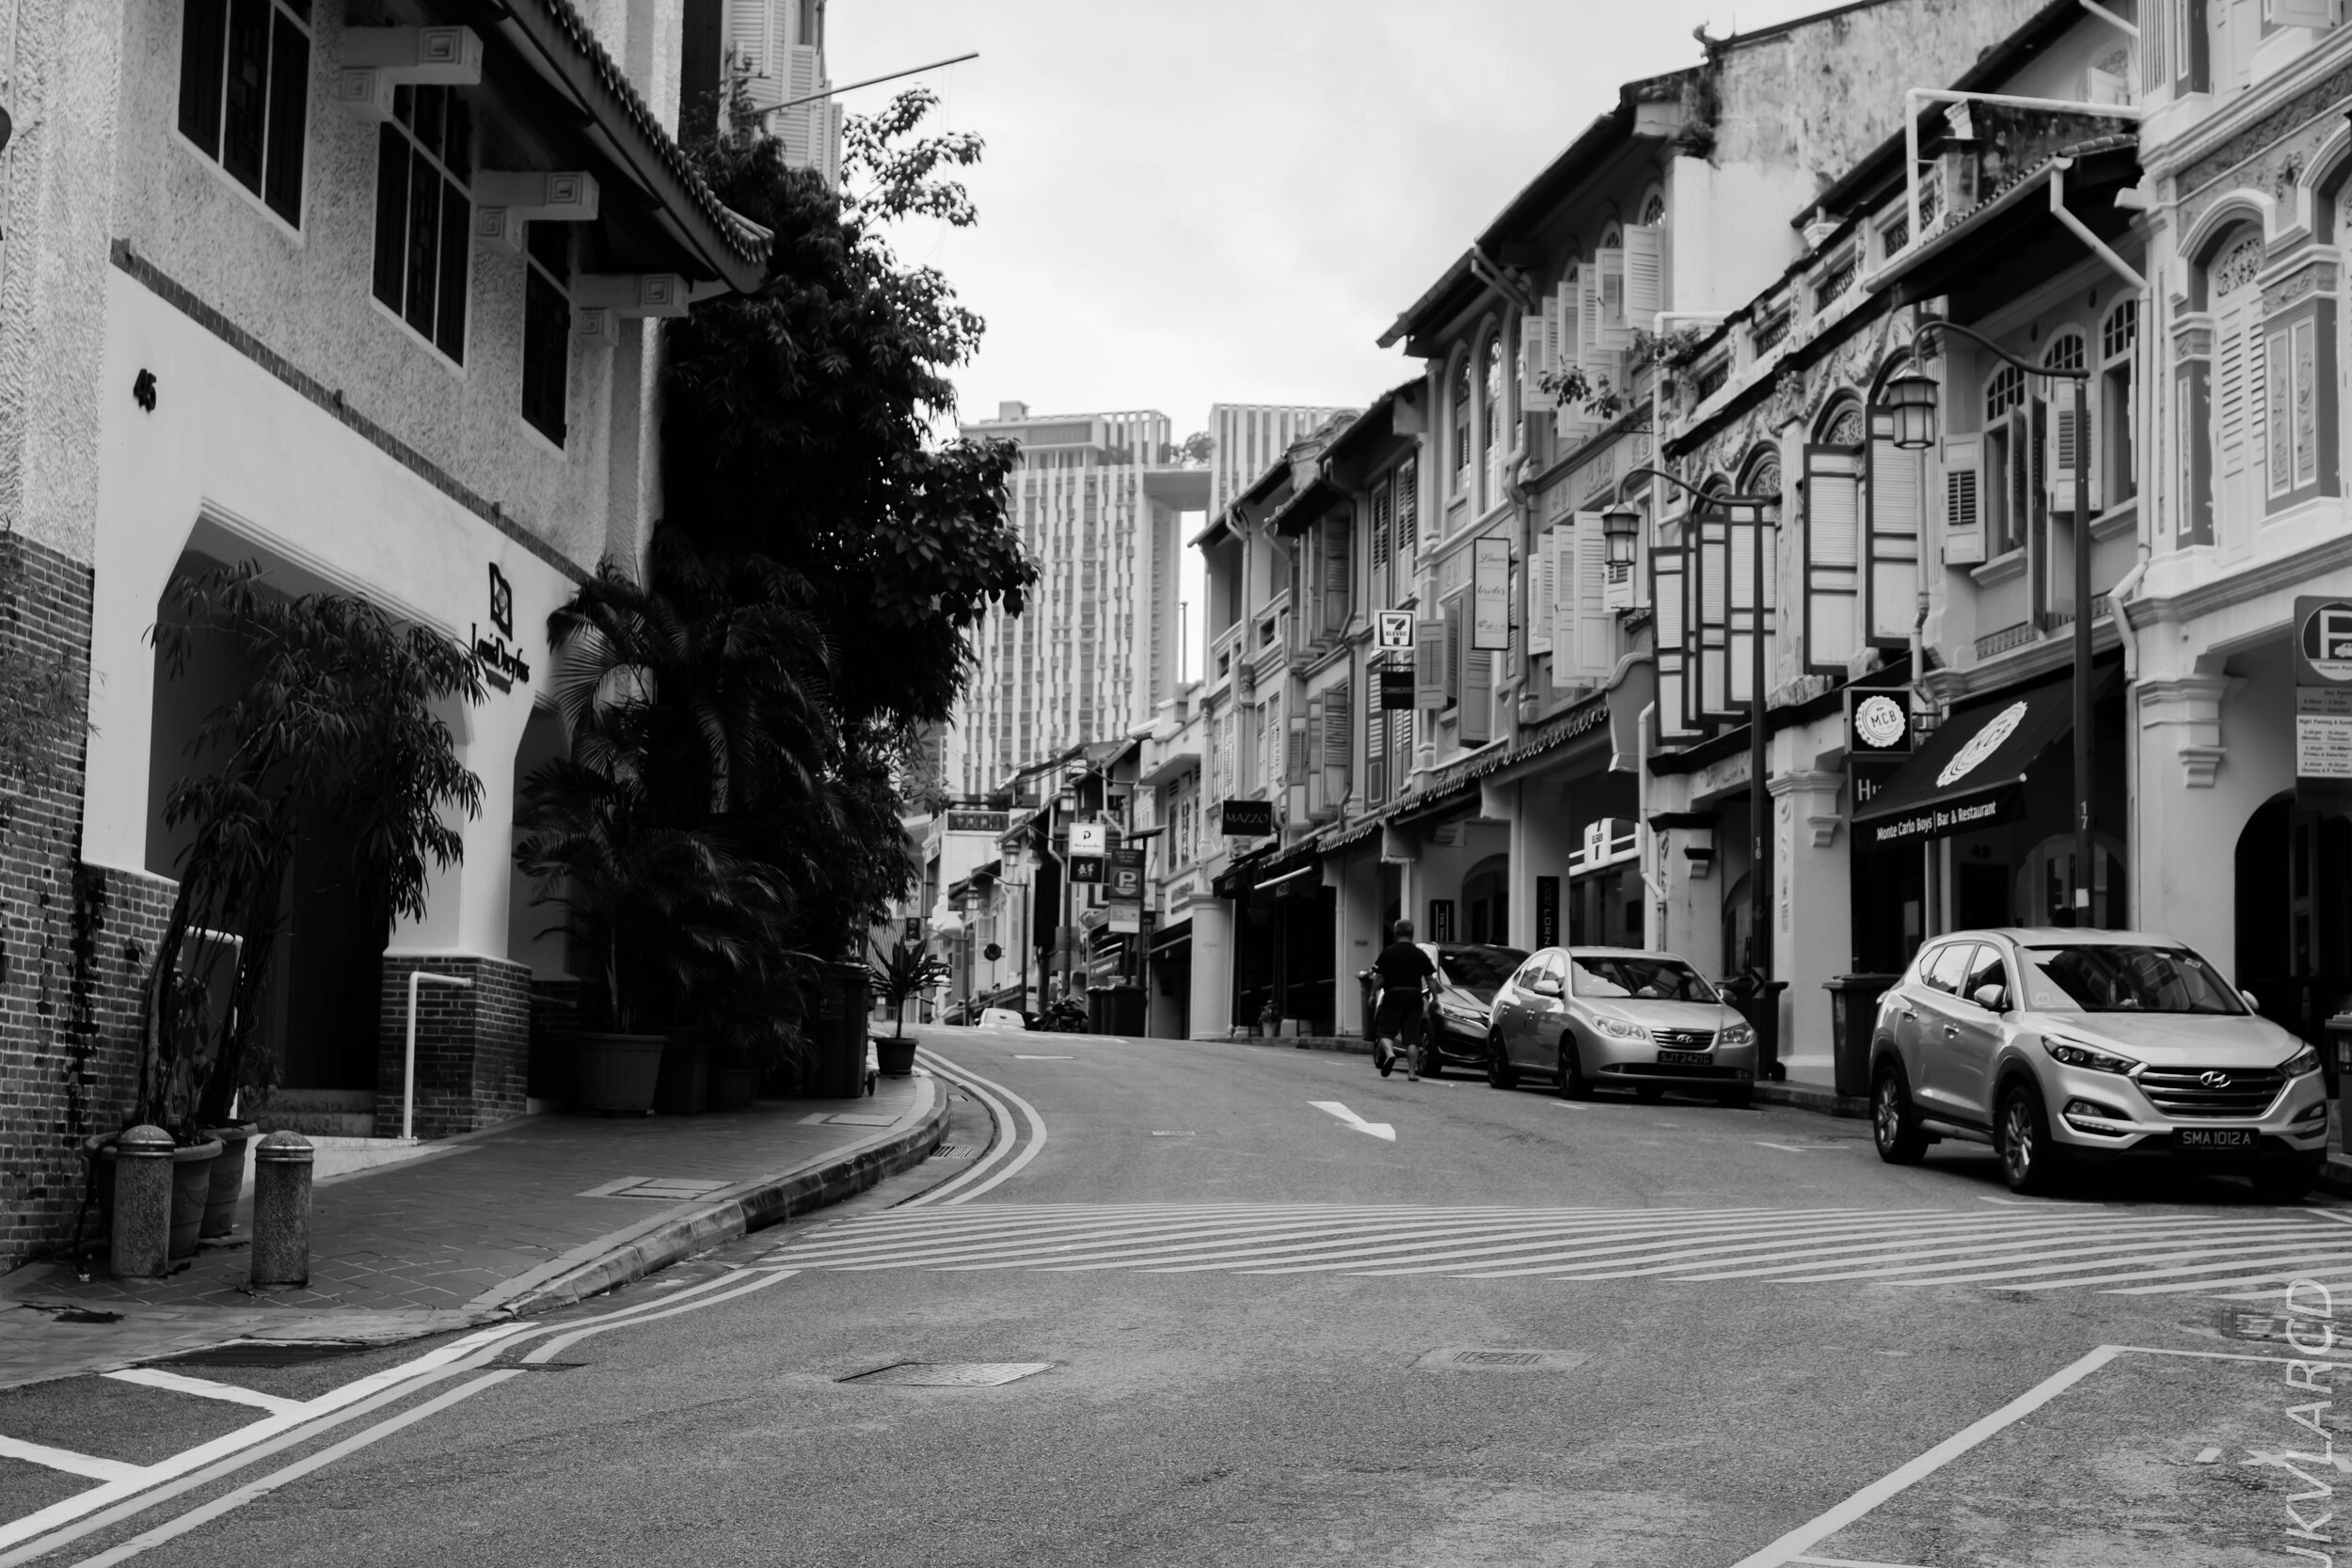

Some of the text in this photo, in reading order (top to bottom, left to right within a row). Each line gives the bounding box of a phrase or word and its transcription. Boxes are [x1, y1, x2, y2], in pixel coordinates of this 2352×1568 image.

[1869, 709, 1898, 729] MCB
[1226, 812, 1269, 824] MAZZO
[1876, 800, 1996, 841] Monte Carlo Boys Bar & Restaurant
[1971, 844, 1993, 859] 42
[1119, 871, 1137, 888] P
